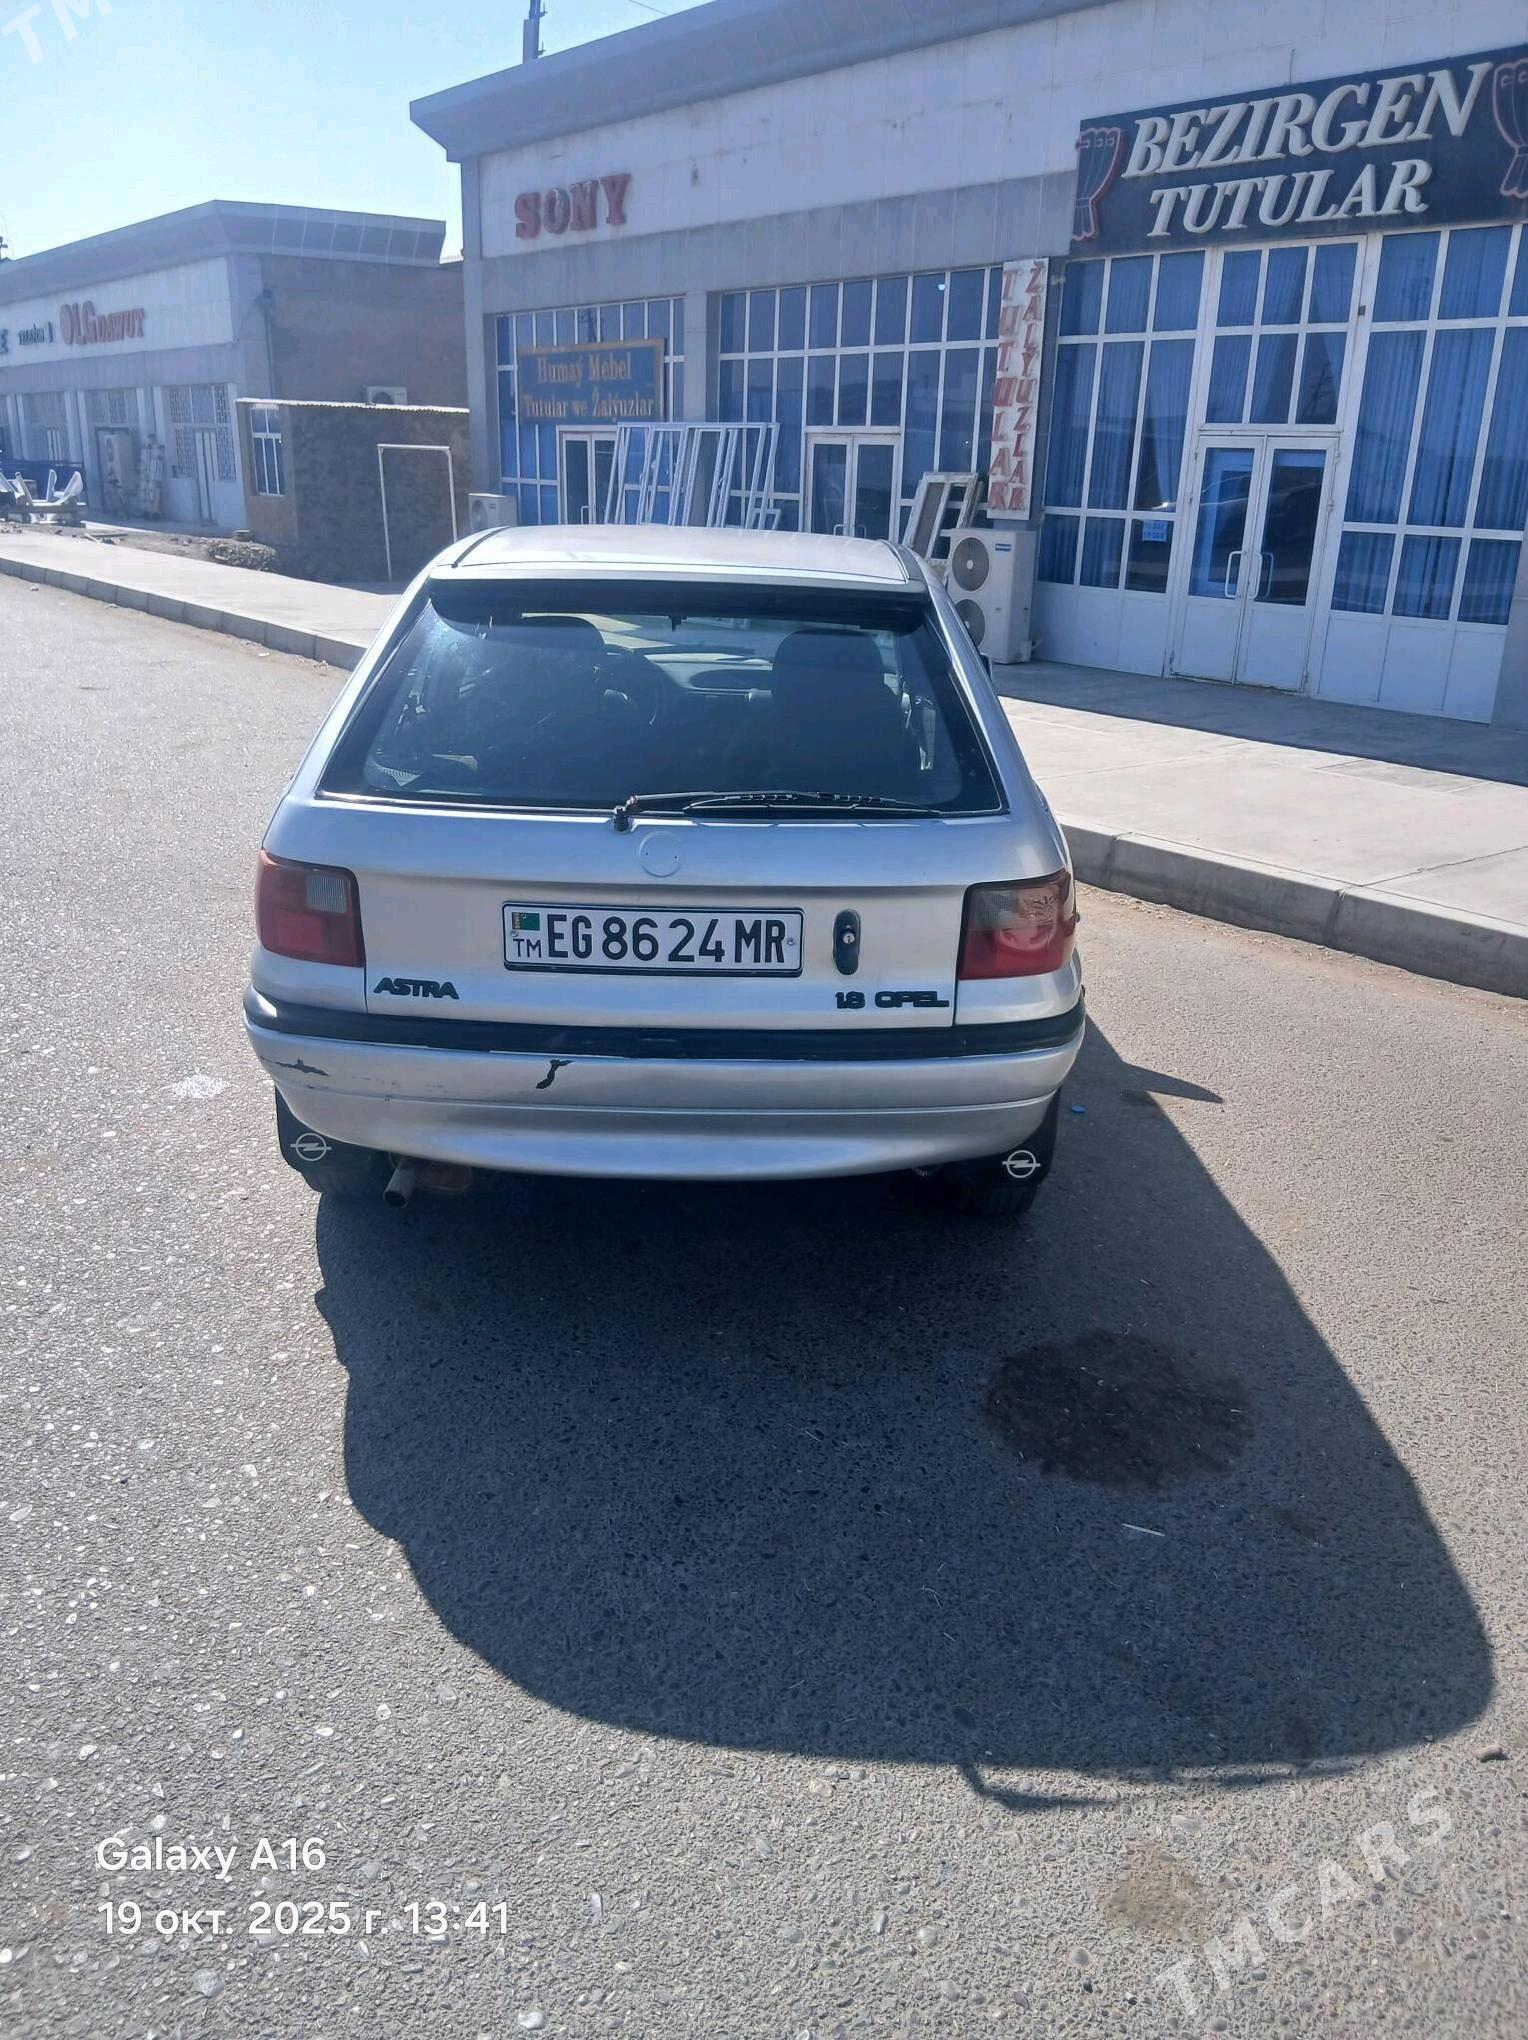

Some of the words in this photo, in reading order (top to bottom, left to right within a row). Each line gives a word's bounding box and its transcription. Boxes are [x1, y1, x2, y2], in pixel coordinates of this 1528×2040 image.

[1121, 61, 1494, 178] BEZIRGEN
[514, 173, 632, 240] SONY
[1147, 159, 1433, 237] TUTULAR
[589, 351, 632, 382] Mebel
[513, 938, 542, 958] TM
[373, 977, 459, 1000] ASTRA
[875, 991, 949, 1008] OPEL
